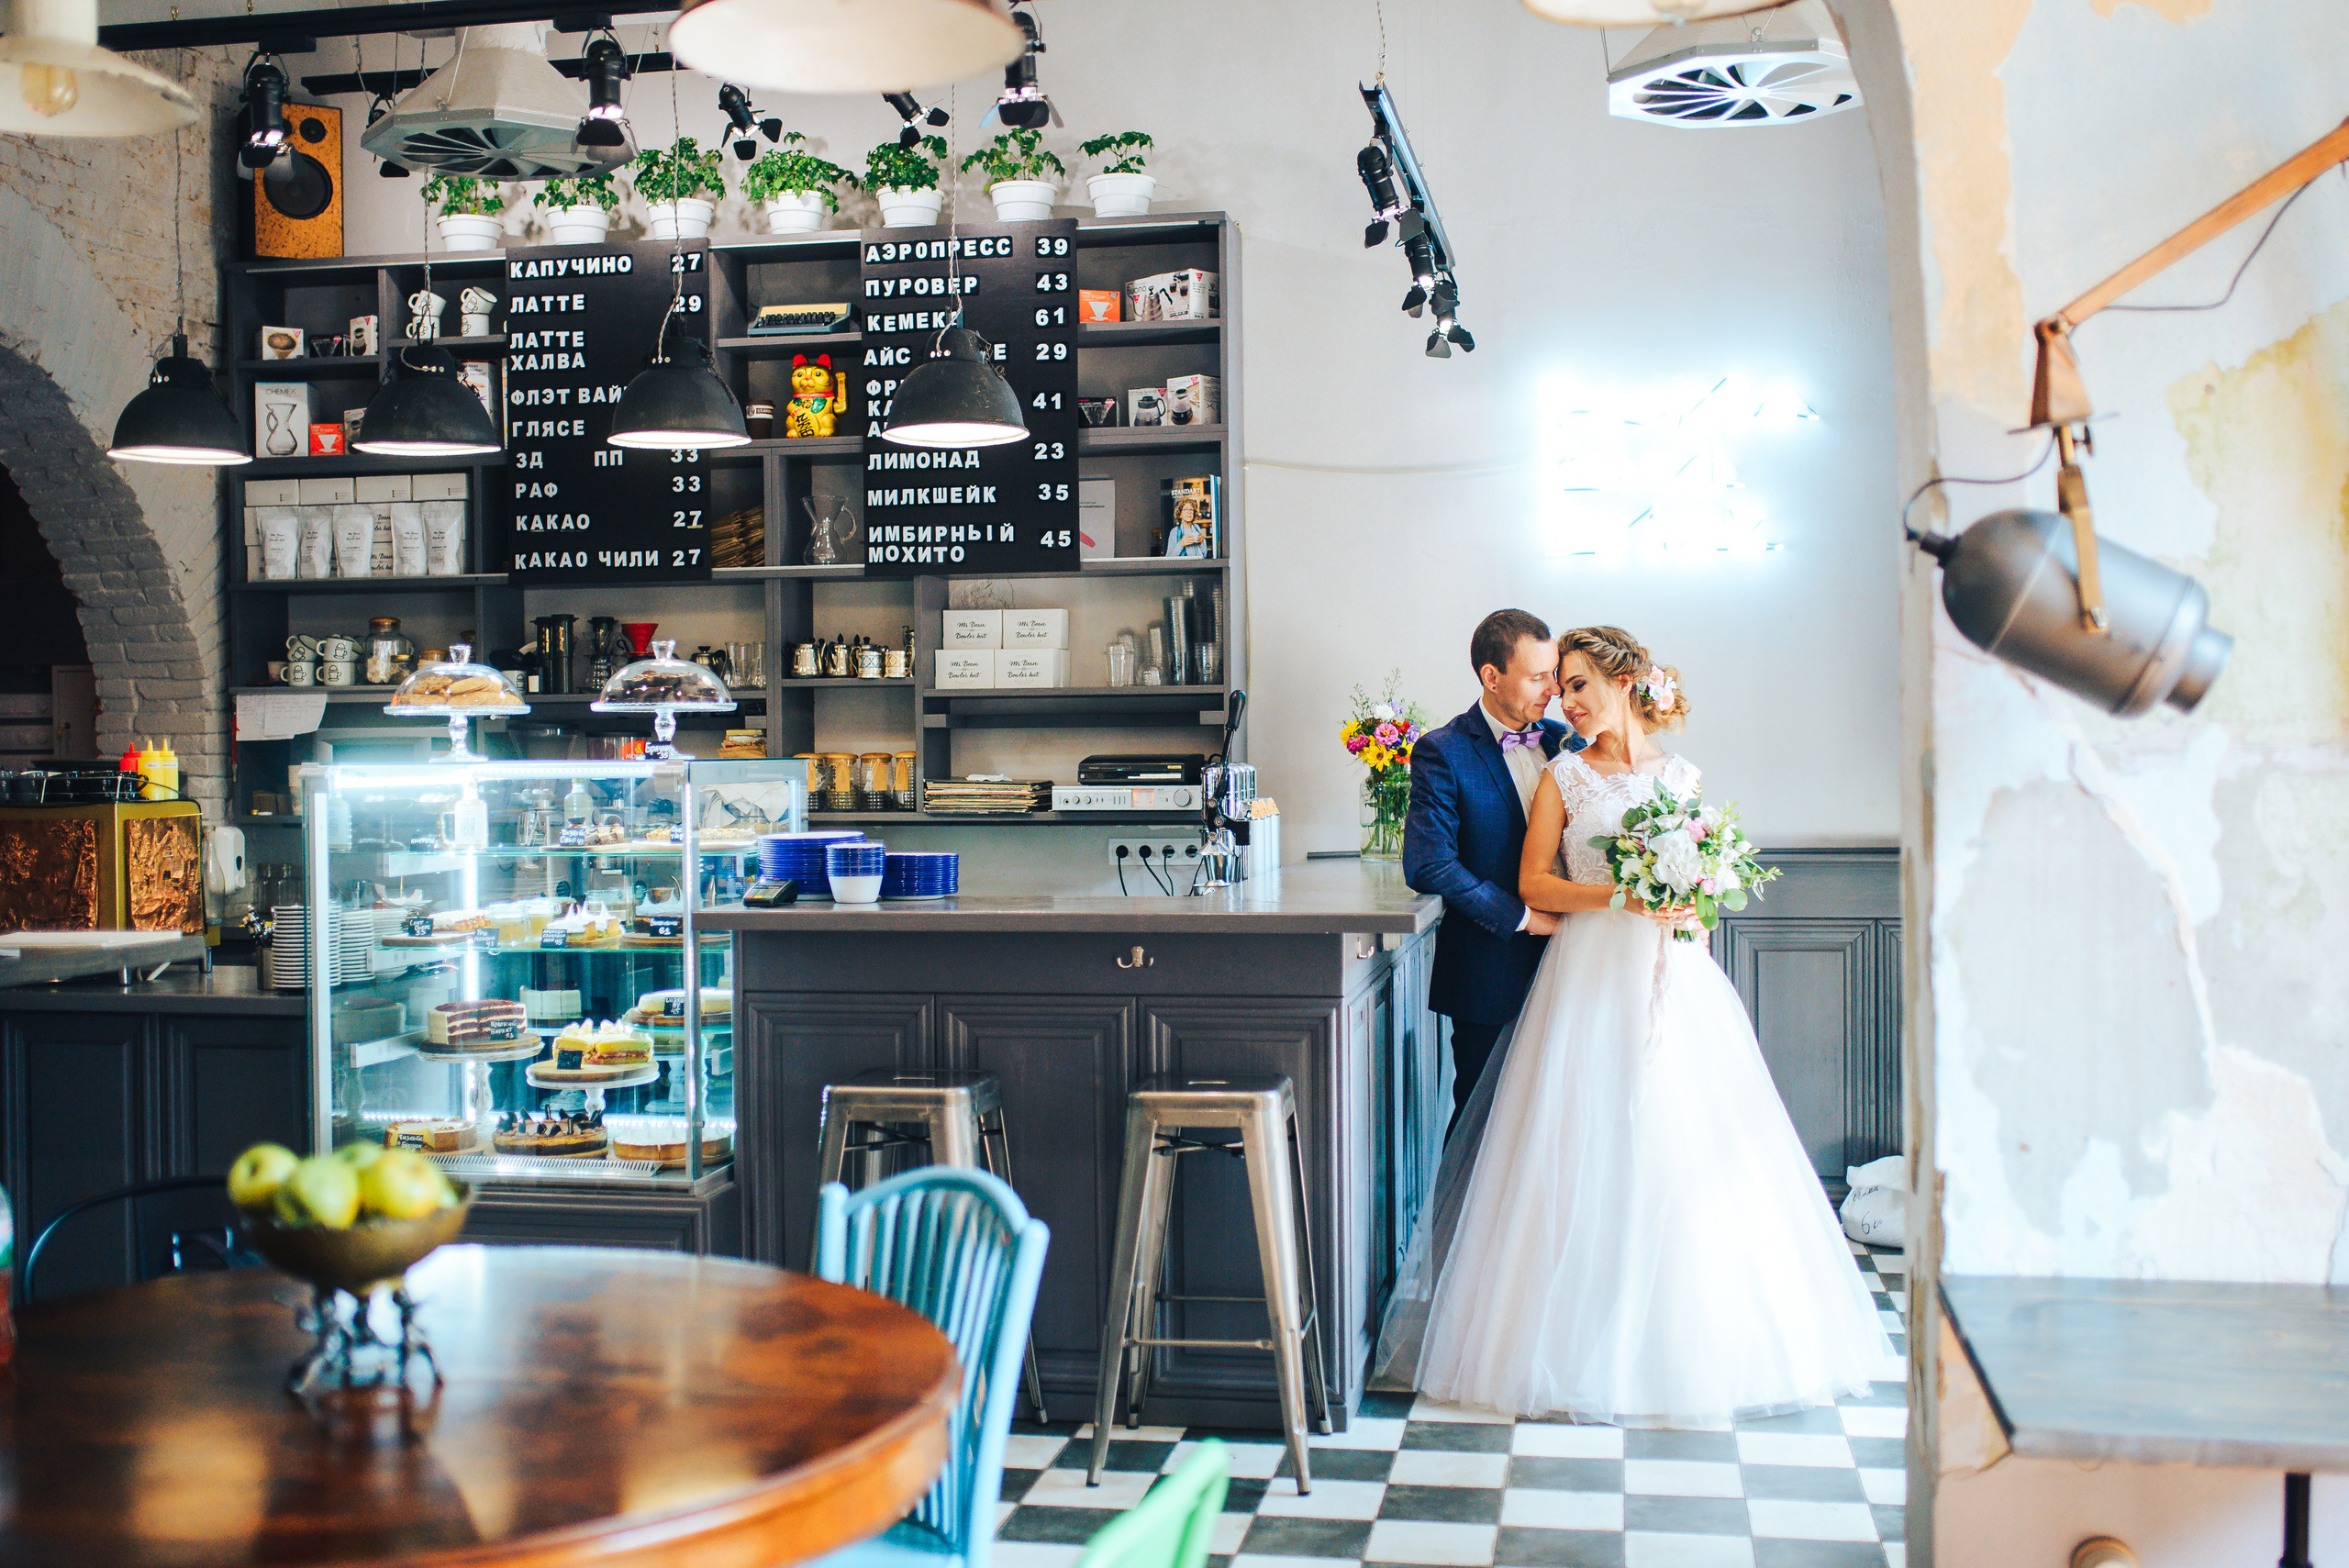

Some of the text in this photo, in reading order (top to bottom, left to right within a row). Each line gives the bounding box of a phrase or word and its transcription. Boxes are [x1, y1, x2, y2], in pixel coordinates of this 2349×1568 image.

[865, 238, 1068, 262] АЭРОПРЕСС 39
[510, 253, 701, 278] КАПУЧИНО 27
[865, 273, 1068, 296] ПУРОВЕР 43
[1127, 285, 1147, 295] Buono
[510, 295, 702, 313] ЛАТТЕ 29
[1035, 307, 1064, 326] 61
[510, 331, 584, 350] ЛАТТЕ
[511, 352, 585, 371] ХАЛВА
[863, 343, 1067, 366] АЙС 29
[511, 385, 628, 406] ФЛЭТ ВАЙ
[1032, 393, 1062, 410] 41
[512, 419, 584, 437] ГЛЯСЕ
[516, 449, 698, 469] ЗД ПП 33
[867, 442, 1064, 470] ЛИМОНАД 23
[516, 476, 701, 498] РАФ 33
[867, 484, 1069, 506] МИЛКШЕЙК 35
[1171, 488, 1200, 496] STANDART
[516, 510, 702, 531] КАКАО 27
[869, 522, 1072, 548] ИМБИРНЫЙ 45
[515, 549, 701, 570] КАКАО ЧИЛИ 27
[868, 545, 965, 563] МОХИТО
[659, 927, 671, 935] 61
